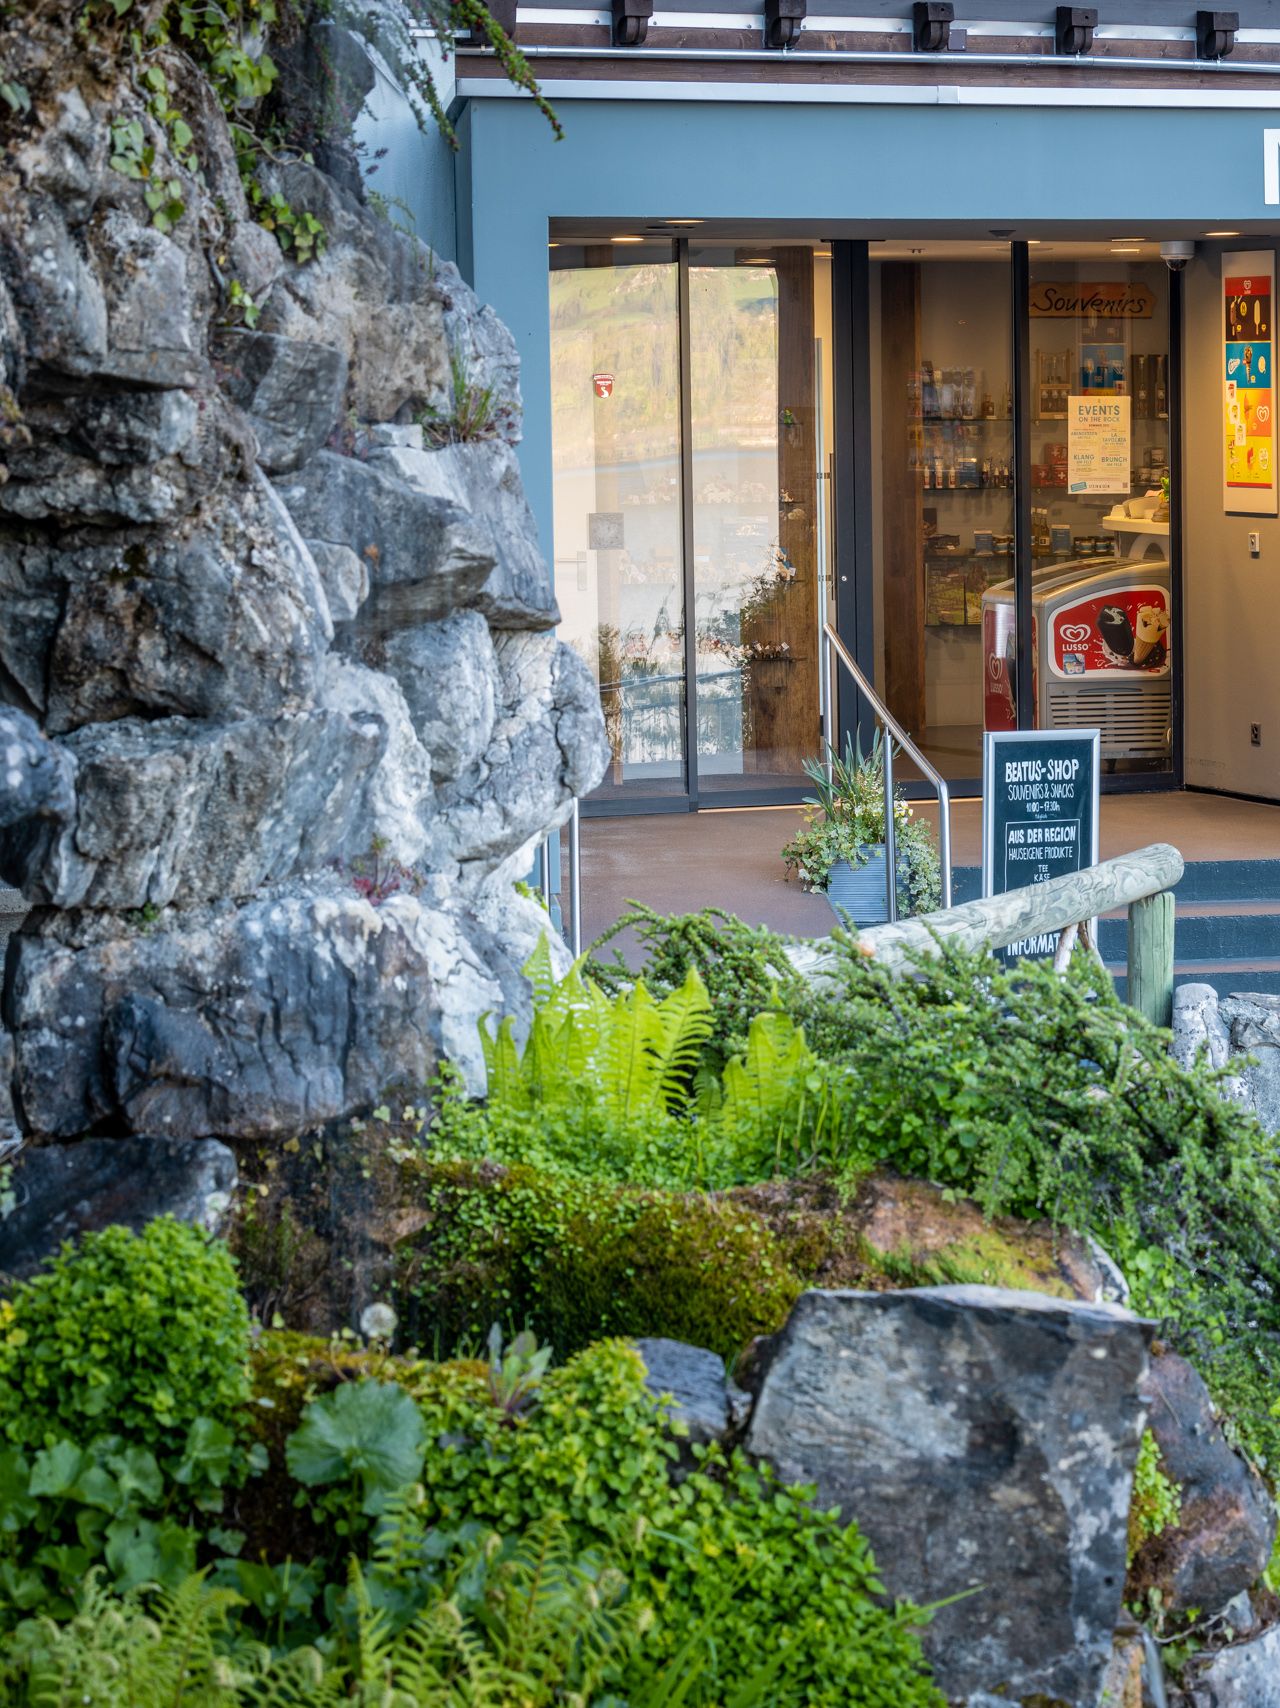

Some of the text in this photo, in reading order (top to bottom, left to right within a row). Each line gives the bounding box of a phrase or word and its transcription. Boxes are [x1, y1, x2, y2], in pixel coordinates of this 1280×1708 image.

[1031, 285, 1147, 314] Souvenirs
[1078, 405, 1120, 416] EVENTS
[1062, 643, 1089, 652] LUSSO
[1008, 783, 1044, 801] SOUVENIRS
[1050, 783, 1075, 799] SNACKS
[1008, 826, 1077, 844] AUS DER REGION
[1008, 846, 1073, 861] HAUSEIGENE PRODUKTE
[1037, 864, 1049, 873] TEE
